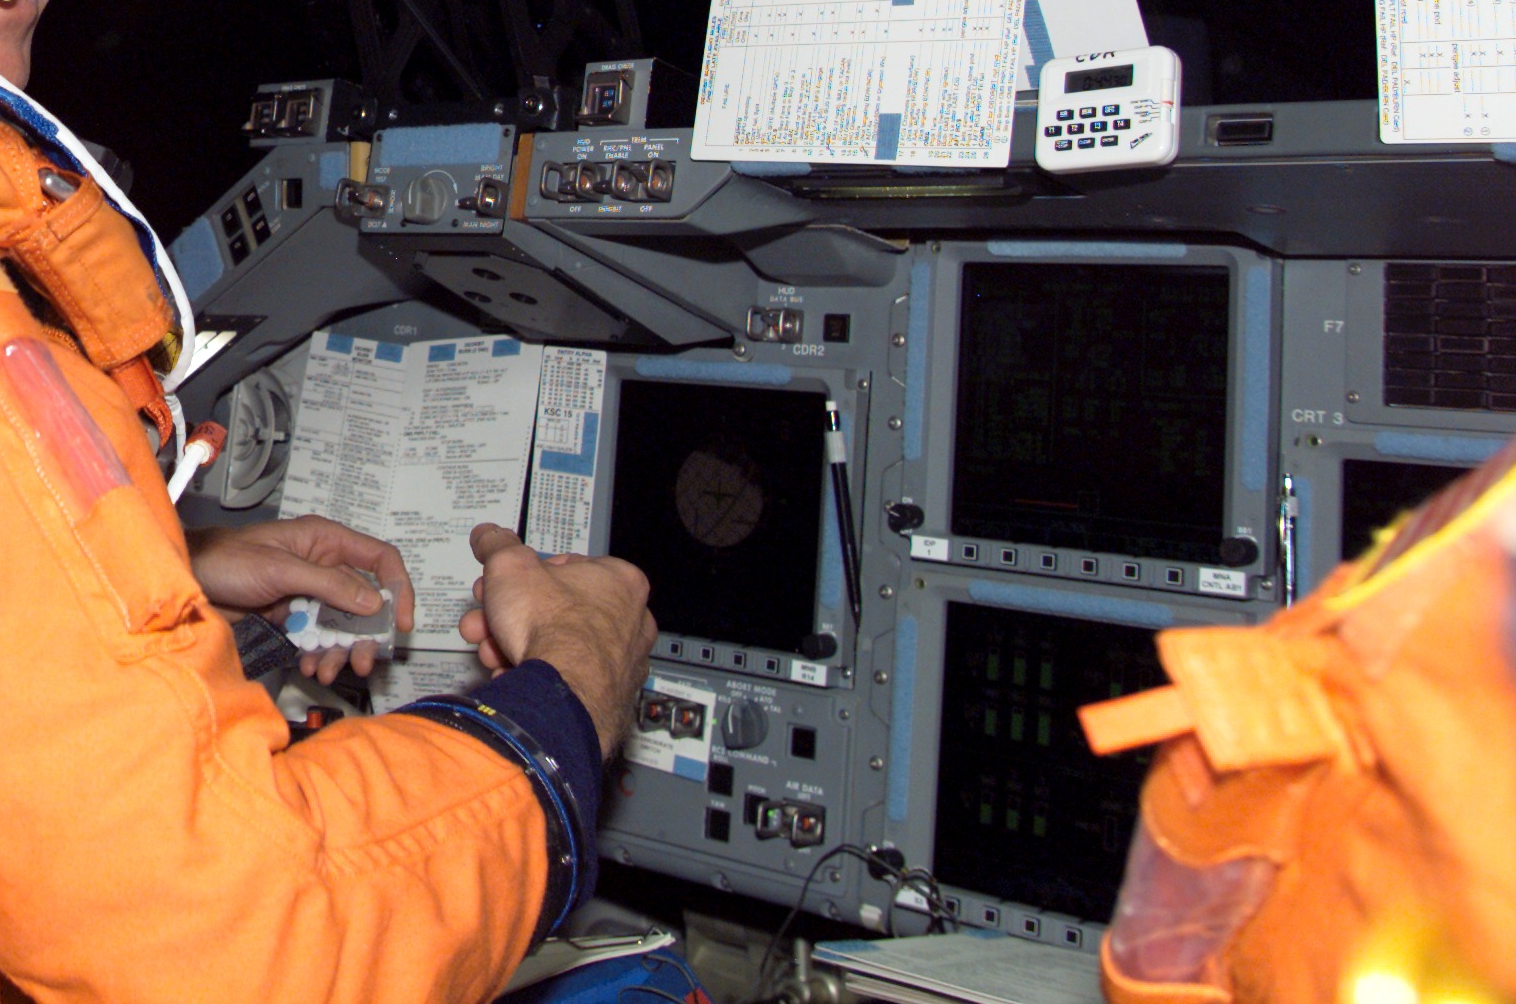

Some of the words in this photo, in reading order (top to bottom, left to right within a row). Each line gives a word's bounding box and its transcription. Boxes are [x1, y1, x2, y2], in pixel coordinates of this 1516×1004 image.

[1323, 319, 1345, 334] F7
[792, 344, 825, 357] CDR2
[544, 407, 562, 417] KSC
[564, 409, 573, 418] 15
[1291, 409, 1325, 424] CRT
[1332, 412, 1344, 425] 3
[726, 680, 751, 691] ABORT
[754, 684, 777, 696] MODE
[786, 781, 799, 791] AIR
[802, 783, 824, 795] DATA
